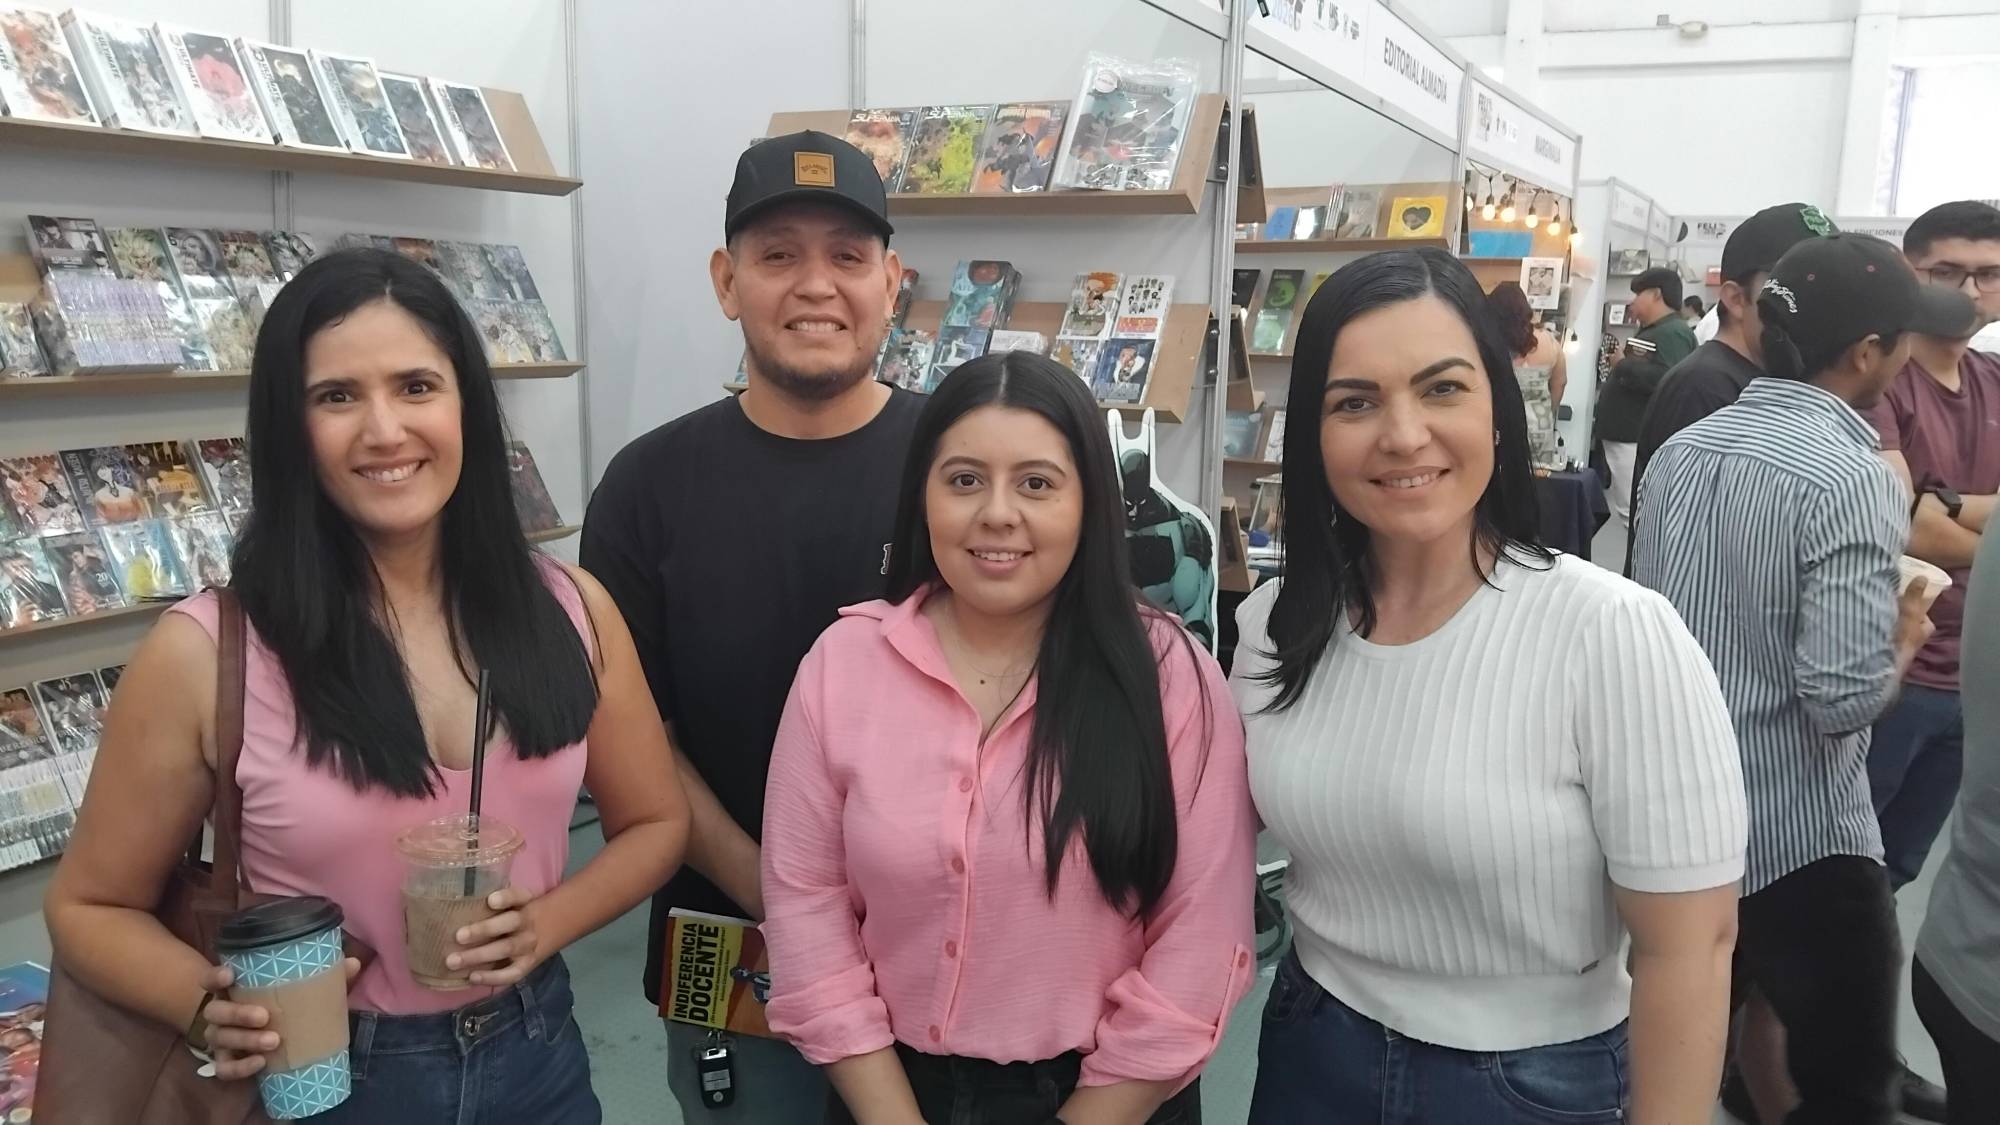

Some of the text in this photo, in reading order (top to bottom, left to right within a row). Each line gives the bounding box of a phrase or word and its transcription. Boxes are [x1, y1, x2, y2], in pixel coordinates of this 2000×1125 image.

[97, 36, 122, 80] ULTIMATE
[175, 48, 201, 89] ULTIMATE
[1384, 37, 1420, 86] EDITORIAL
[261, 61, 283, 104] ULTIMATE
[850, 112, 902, 124] SUPERMAN
[96, 572, 109, 584] 20
[674, 923, 697, 1019] INDIFERENCIA
[688, 924, 719, 1023] DOCENTE
